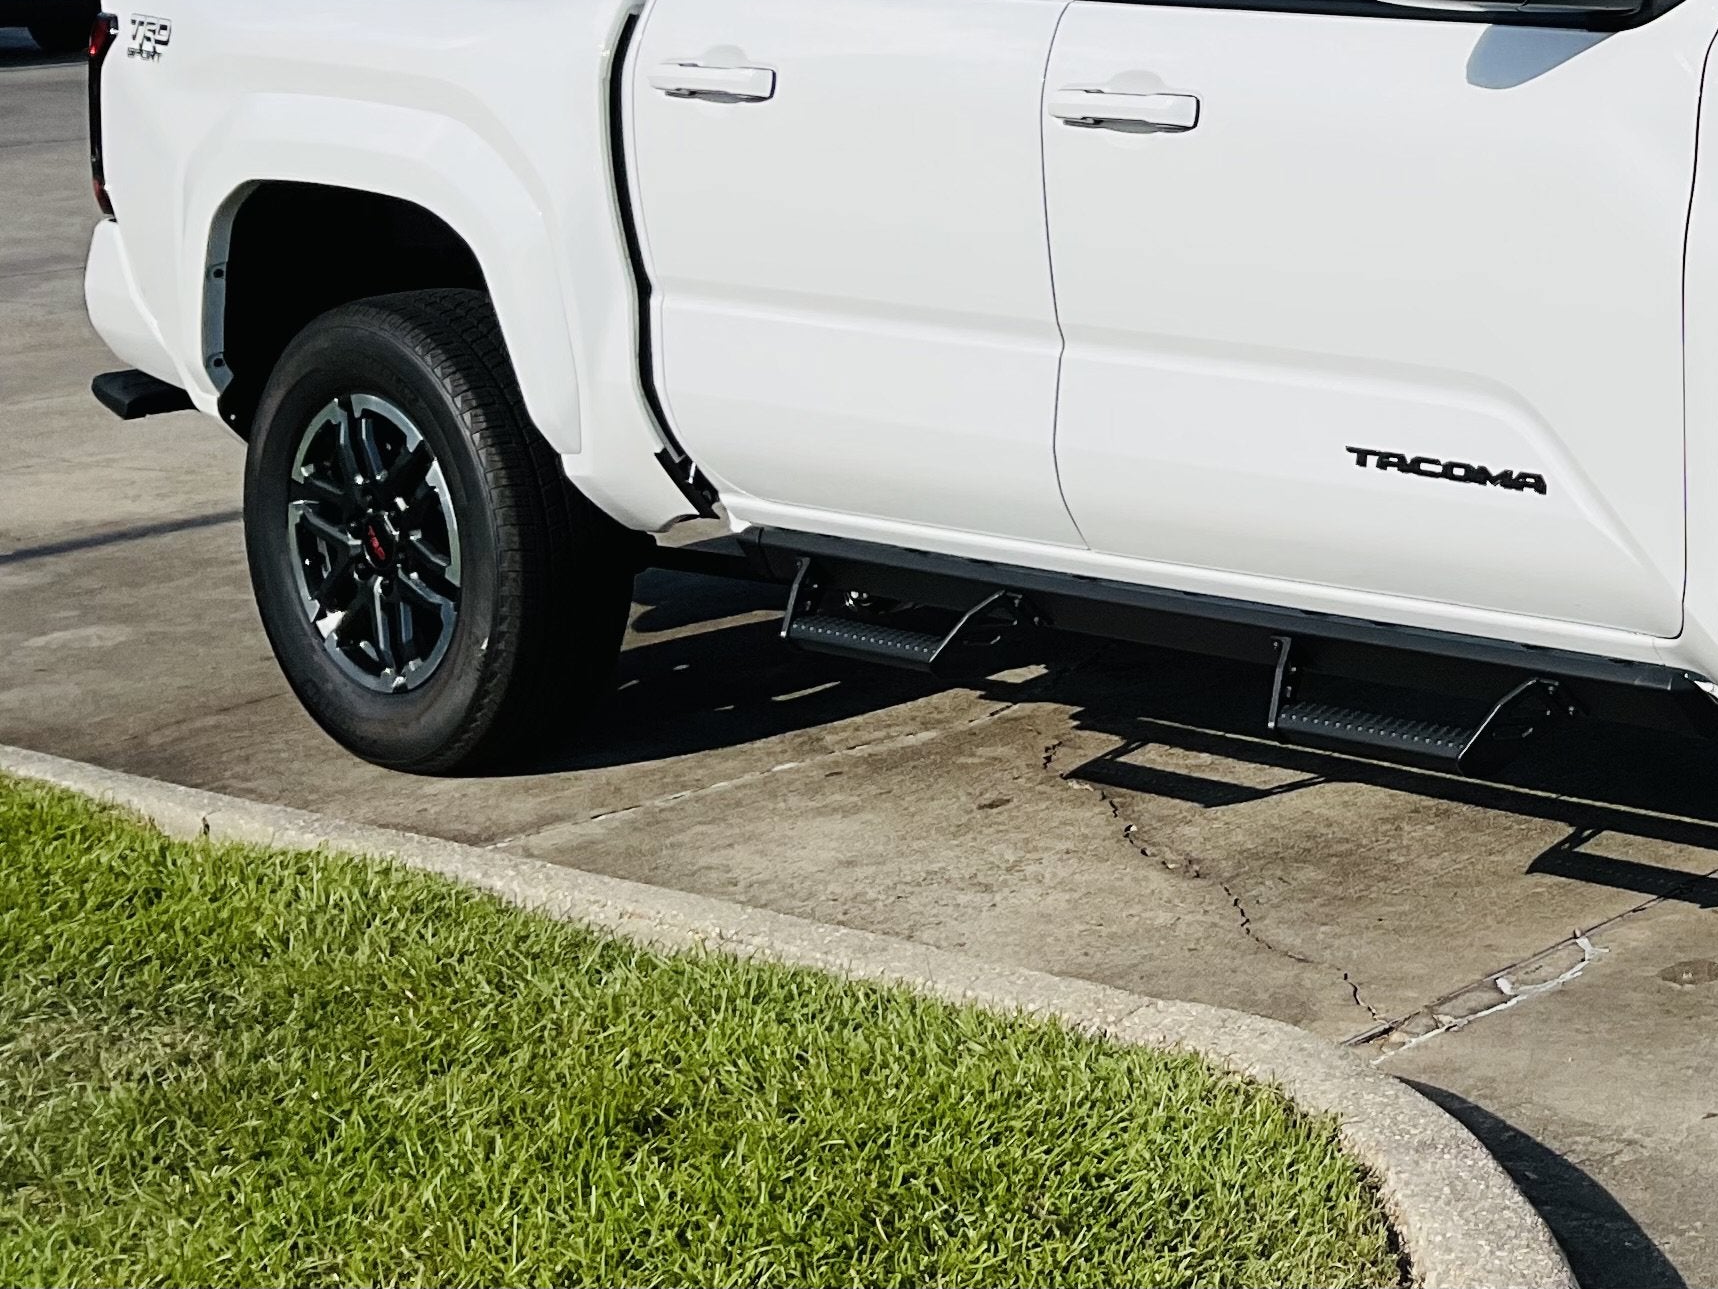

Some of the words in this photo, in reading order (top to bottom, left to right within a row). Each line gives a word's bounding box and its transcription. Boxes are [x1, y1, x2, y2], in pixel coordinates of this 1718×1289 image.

[130, 13, 173, 53] TRD
[127, 47, 163, 62] SPORT
[1345, 445, 1548, 496] TACOMA
